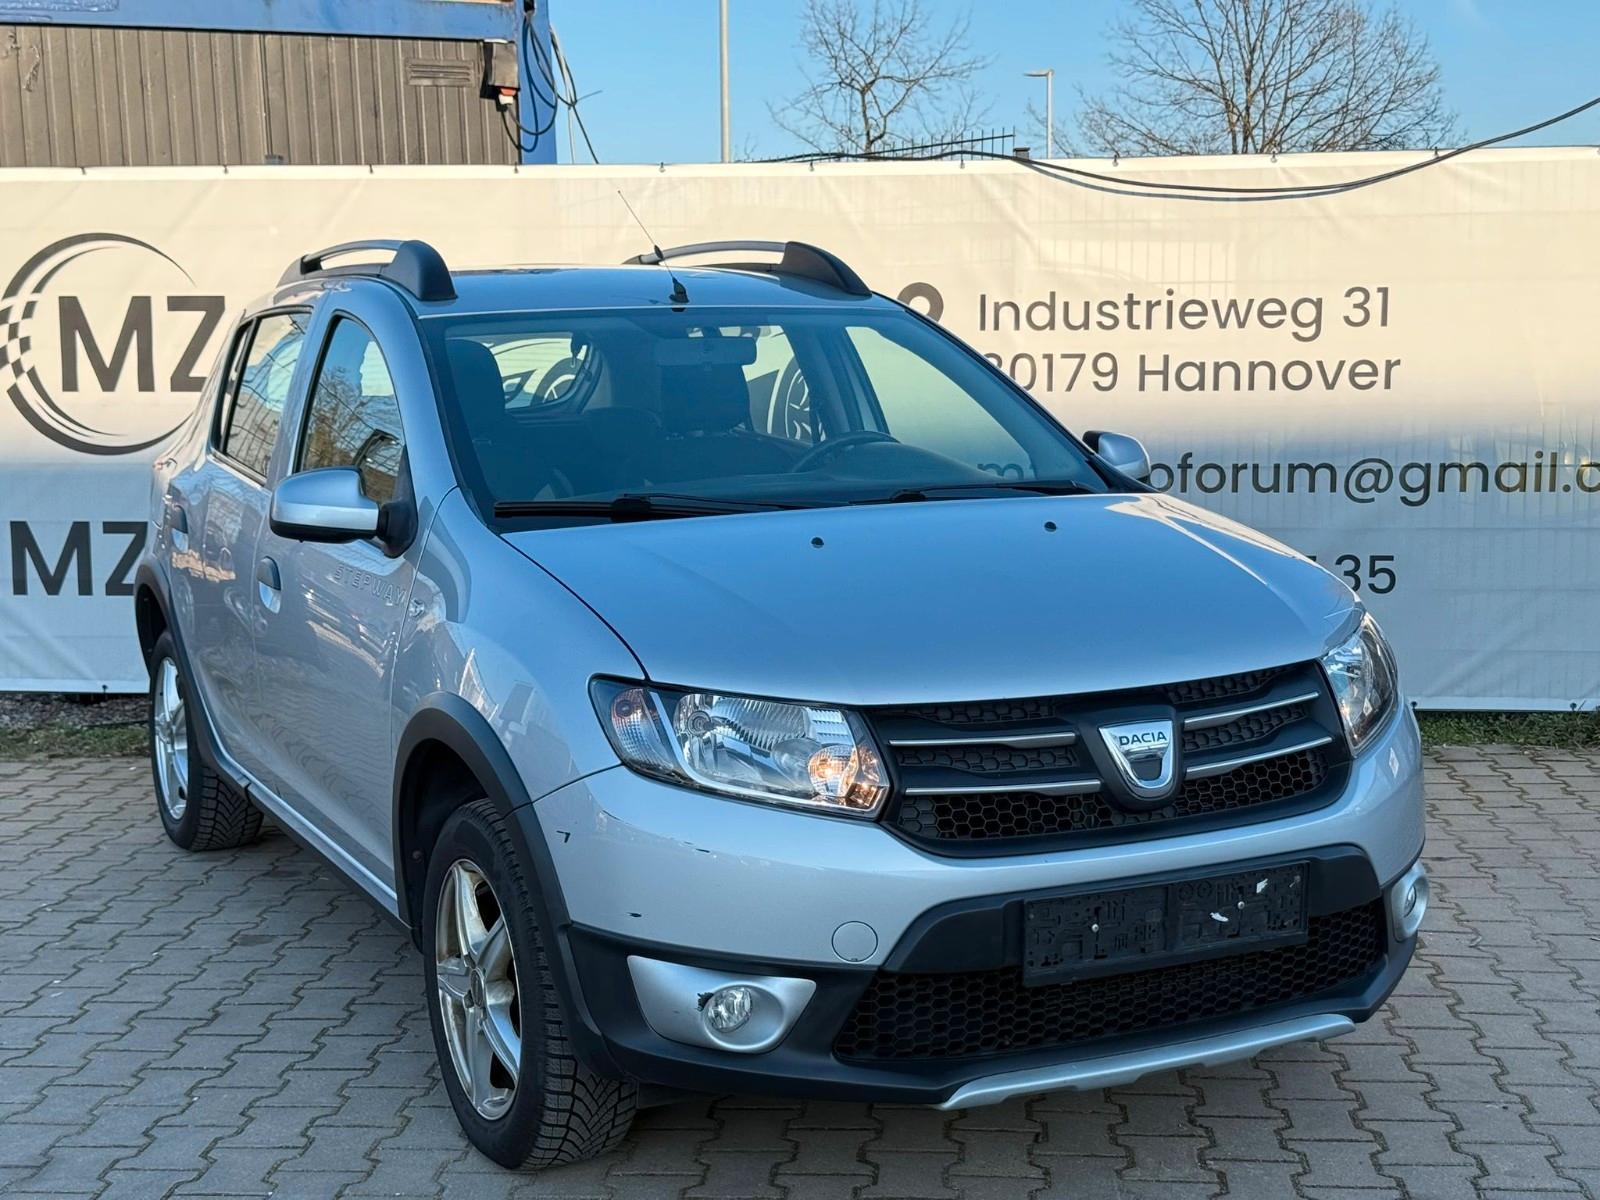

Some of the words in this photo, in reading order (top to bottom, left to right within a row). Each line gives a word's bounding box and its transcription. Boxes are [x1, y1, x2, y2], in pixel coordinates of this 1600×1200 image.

[978, 288, 1323, 343] Industrieweg
[1343, 286, 1389, 327] 31
[58, 295, 226, 393] MZ
[1138, 354, 1402, 392] Hannover
[9, 521, 148, 596] MZ
[334, 563, 408, 606] STEPWAY
[1119, 731, 1167, 746] DACIA
